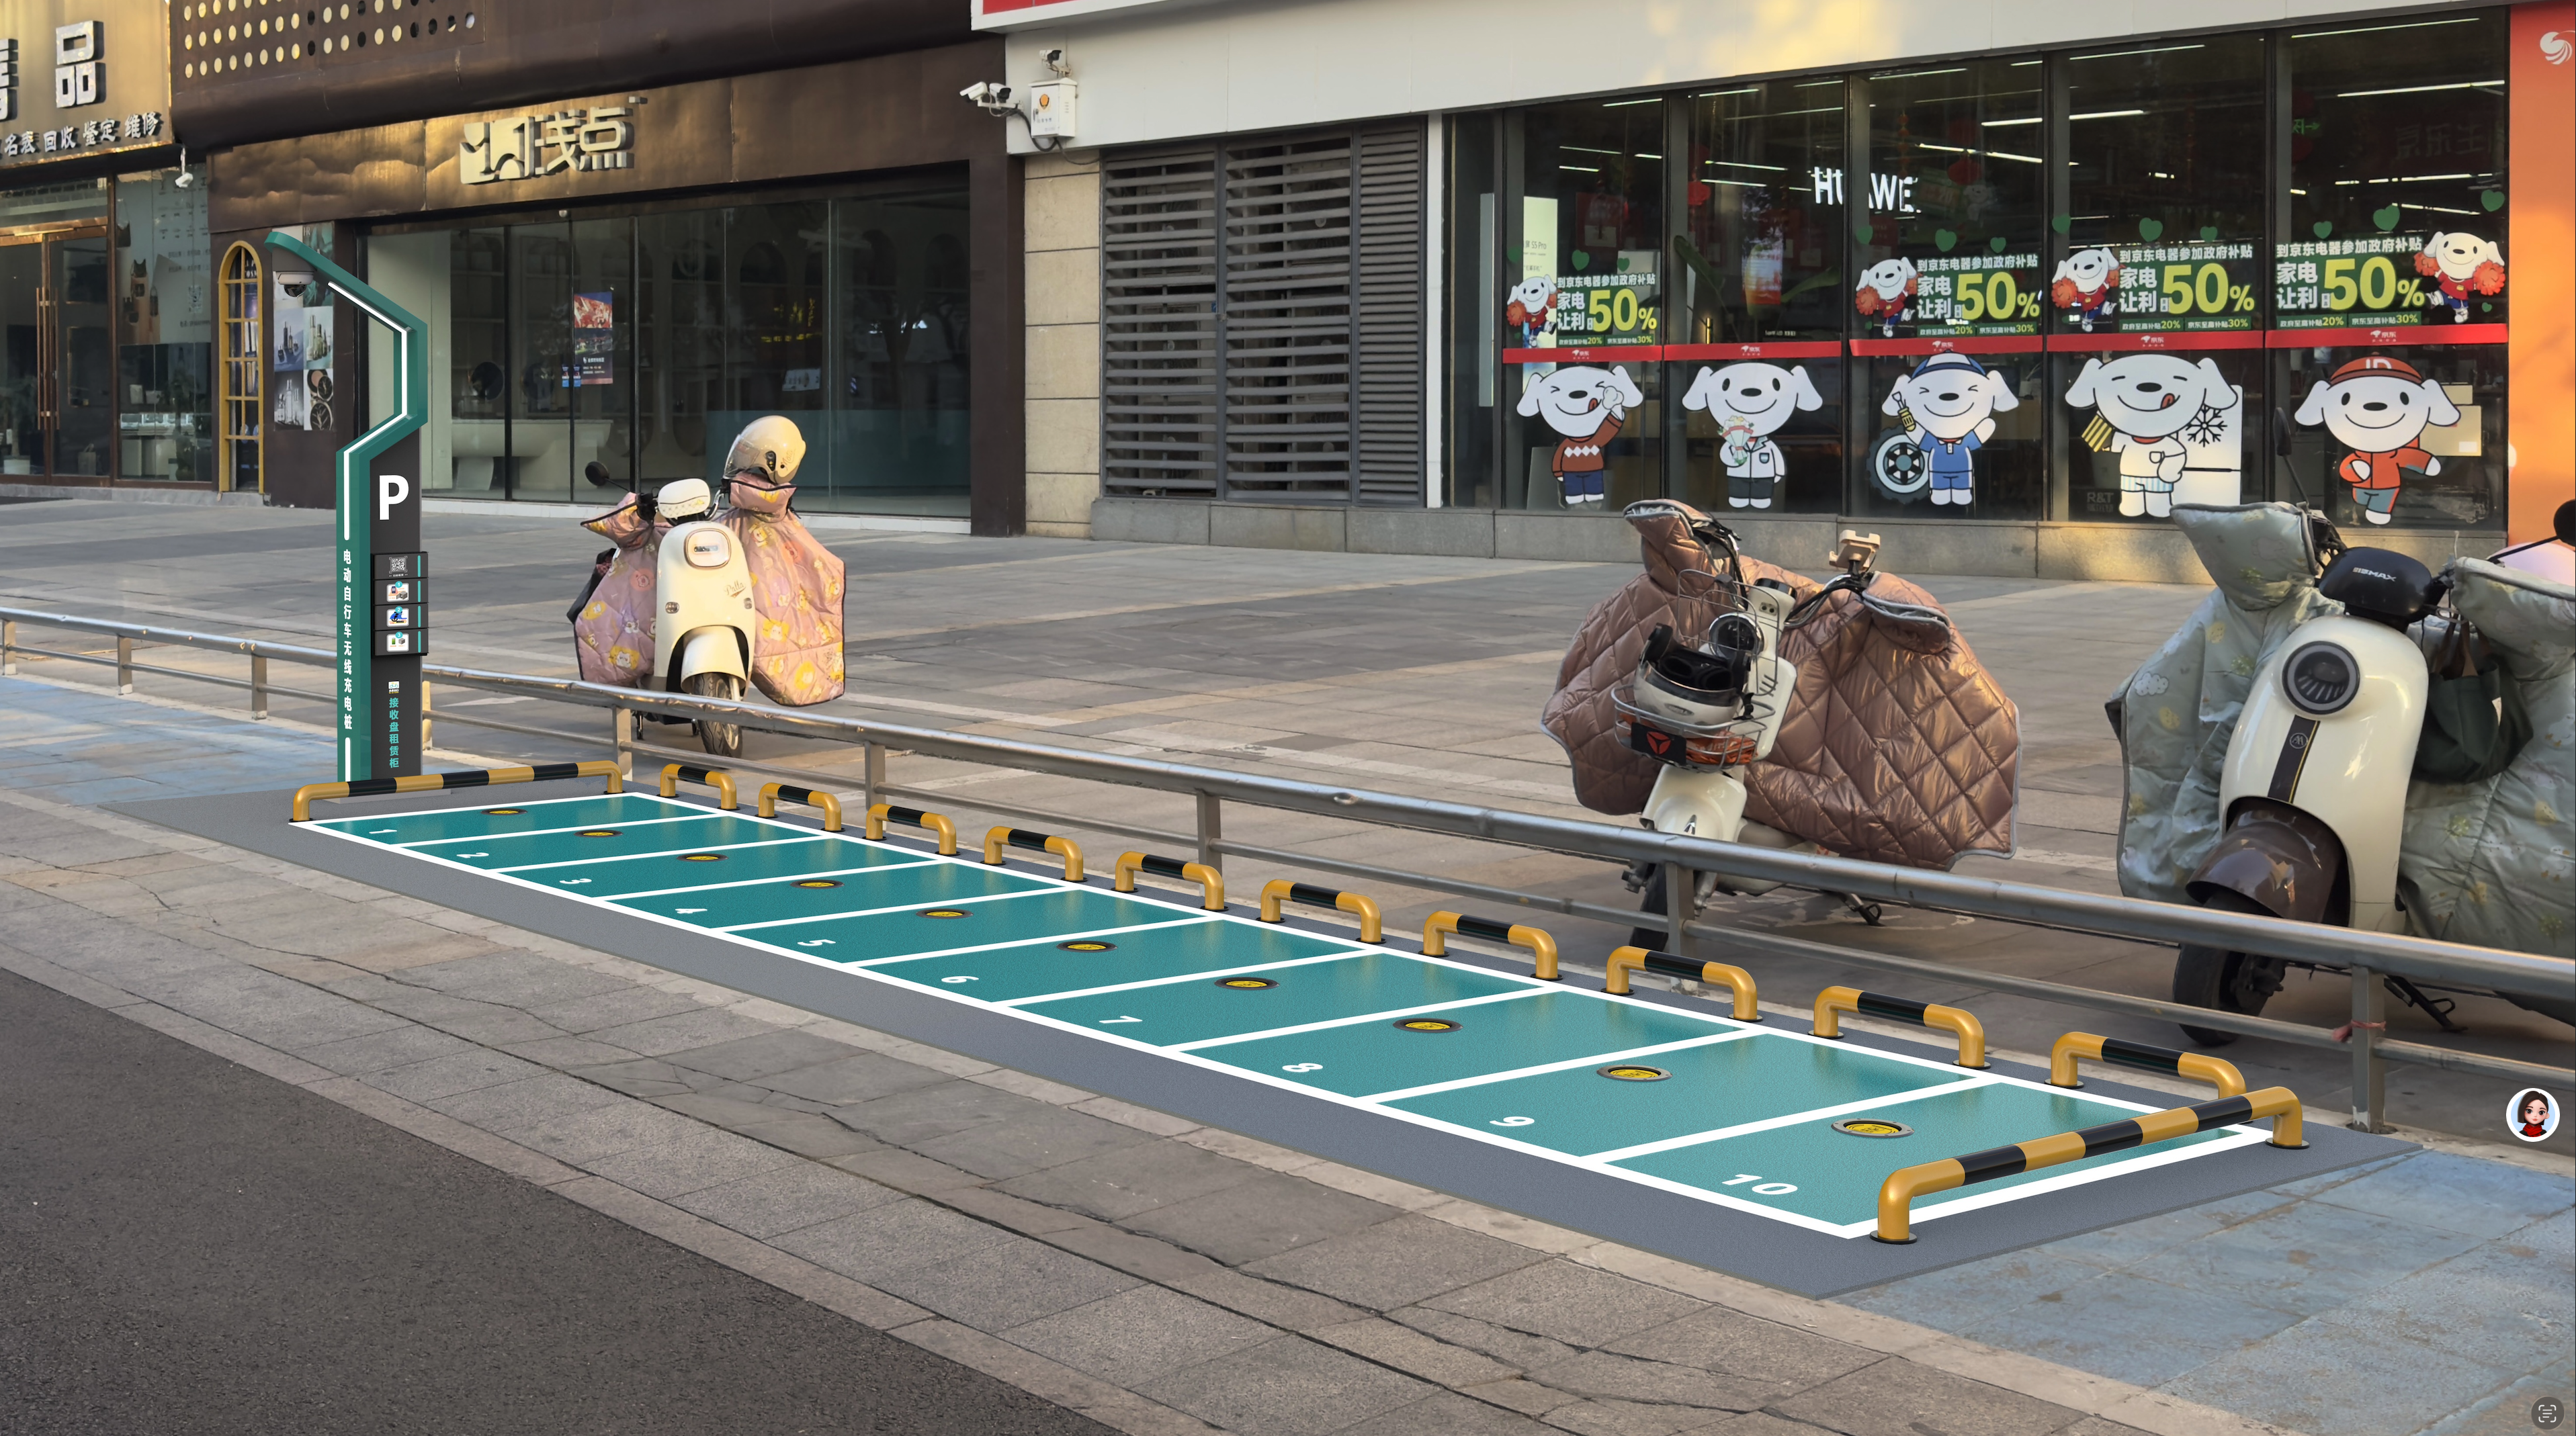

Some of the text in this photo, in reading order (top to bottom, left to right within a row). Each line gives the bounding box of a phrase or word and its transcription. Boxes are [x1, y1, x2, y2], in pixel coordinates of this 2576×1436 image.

[44, 126, 77, 152] 回收
[83, 120, 116, 146] 鉴定
[125, 111, 160, 139] 维修
[2120, 245, 2253, 263] 到京东电器参加政府补贴
[2276, 238, 2422, 257] 到京东电器参加政府补贴
[1917, 255, 2038, 271] 到京东电器参加政府补贴
[2277, 261, 2318, 285] 家电
[1557, 273, 1656, 288] 到京东电器参加政府补贴
[1917, 275, 1951, 296] 家电
[2119, 291, 2157, 313] 让利
[2163, 263, 2255, 315] 50%
[2120, 267, 2157, 289] 家电
[2276, 286, 2317, 310] 让利
[2324, 257, 2425, 310] 50%
[1557, 291, 1585, 310] 家电
[1917, 298, 1951, 319] 让利
[1957, 271, 2040, 320] 50%
[1557, 312, 1584, 330] 让利
[1589, 288, 1657, 332] 50%
[380, 475, 409, 521] P
[2087, 492, 2114, 503] R&T
[343, 549, 353, 730] 电动自行车无线充电桩
[388, 698, 400, 768] 接收盘租赁柜
[1283, 1063, 1323, 1072] 8
[1490, 1116, 1535, 1126] 9
[1721, 1174, 1797, 1196] 10
